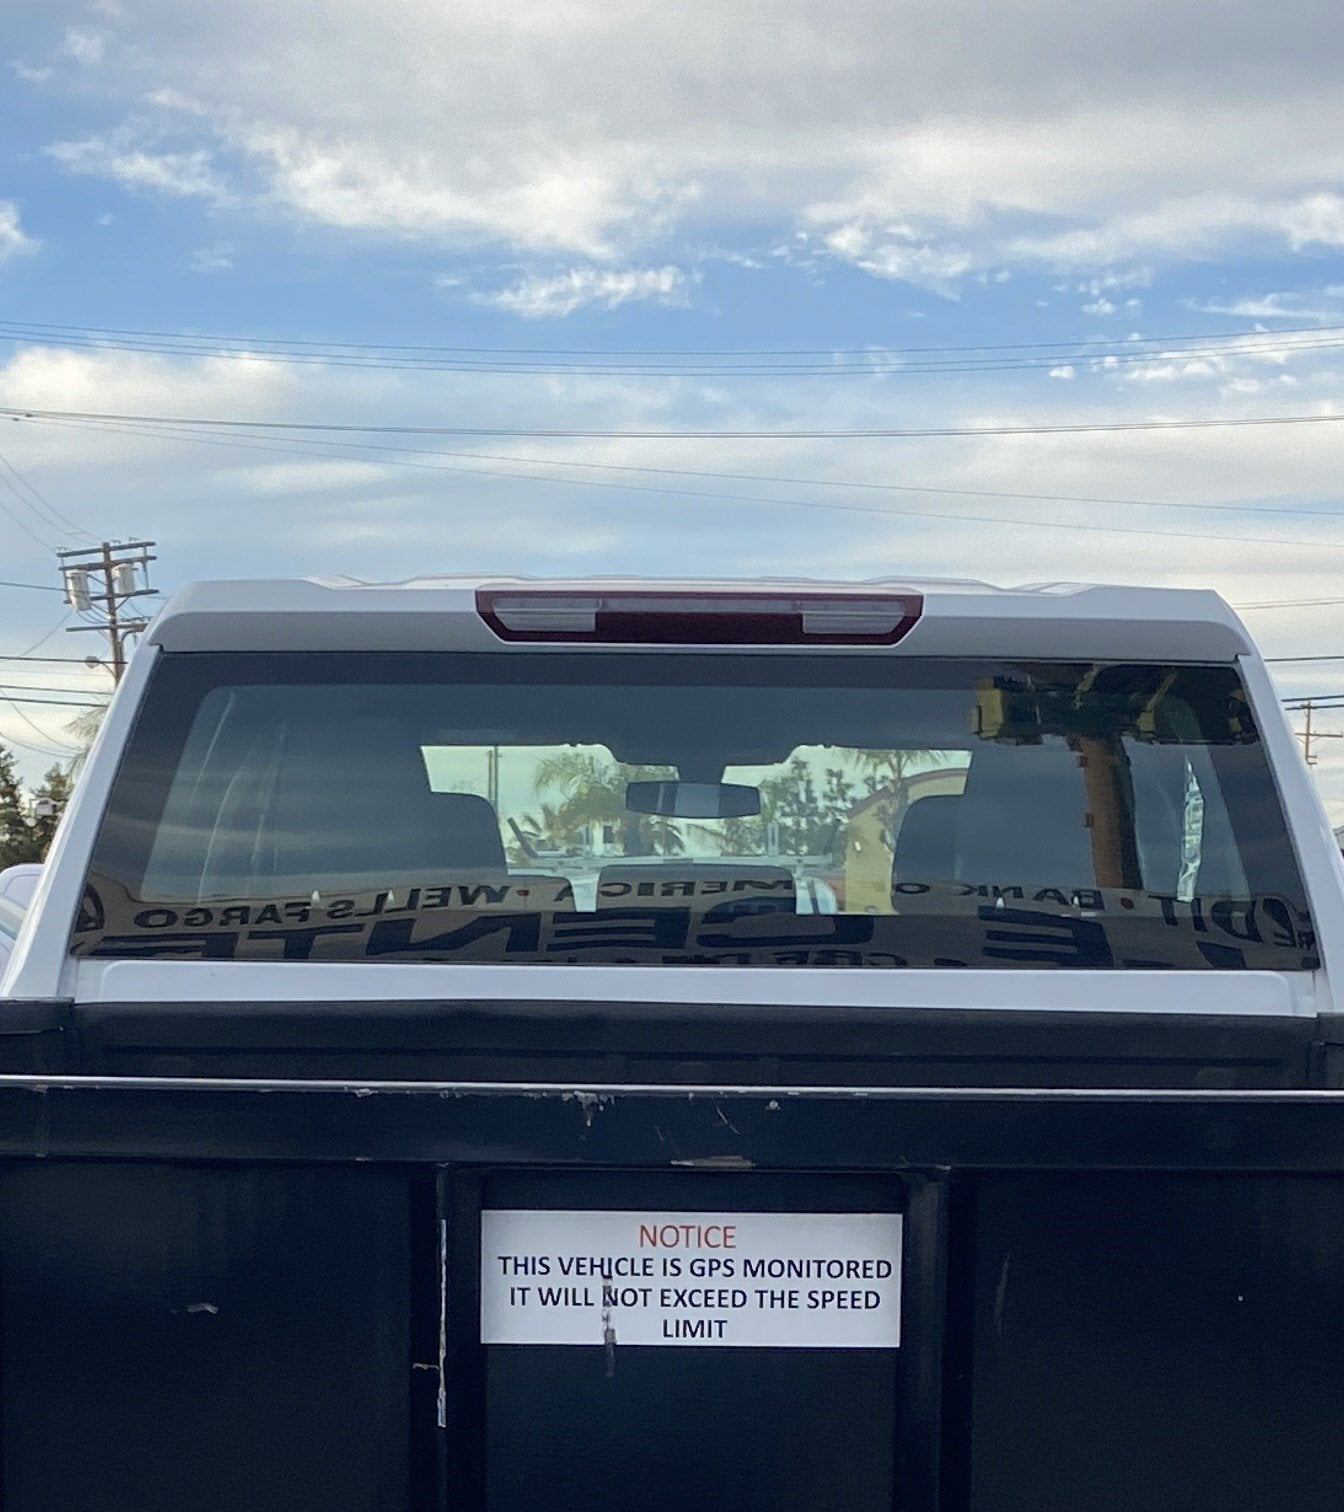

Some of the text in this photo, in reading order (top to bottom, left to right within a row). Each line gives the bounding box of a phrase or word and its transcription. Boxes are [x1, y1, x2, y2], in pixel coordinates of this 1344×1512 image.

[639, 1224, 737, 1249] NOTICE
[497, 1256, 892, 1279] THIS VEHICLE IS GPS MONITORED
[510, 1286, 881, 1309] IT WILL NOT EXCEED THE SPEED
[662, 1319, 728, 1339] LIMIT
